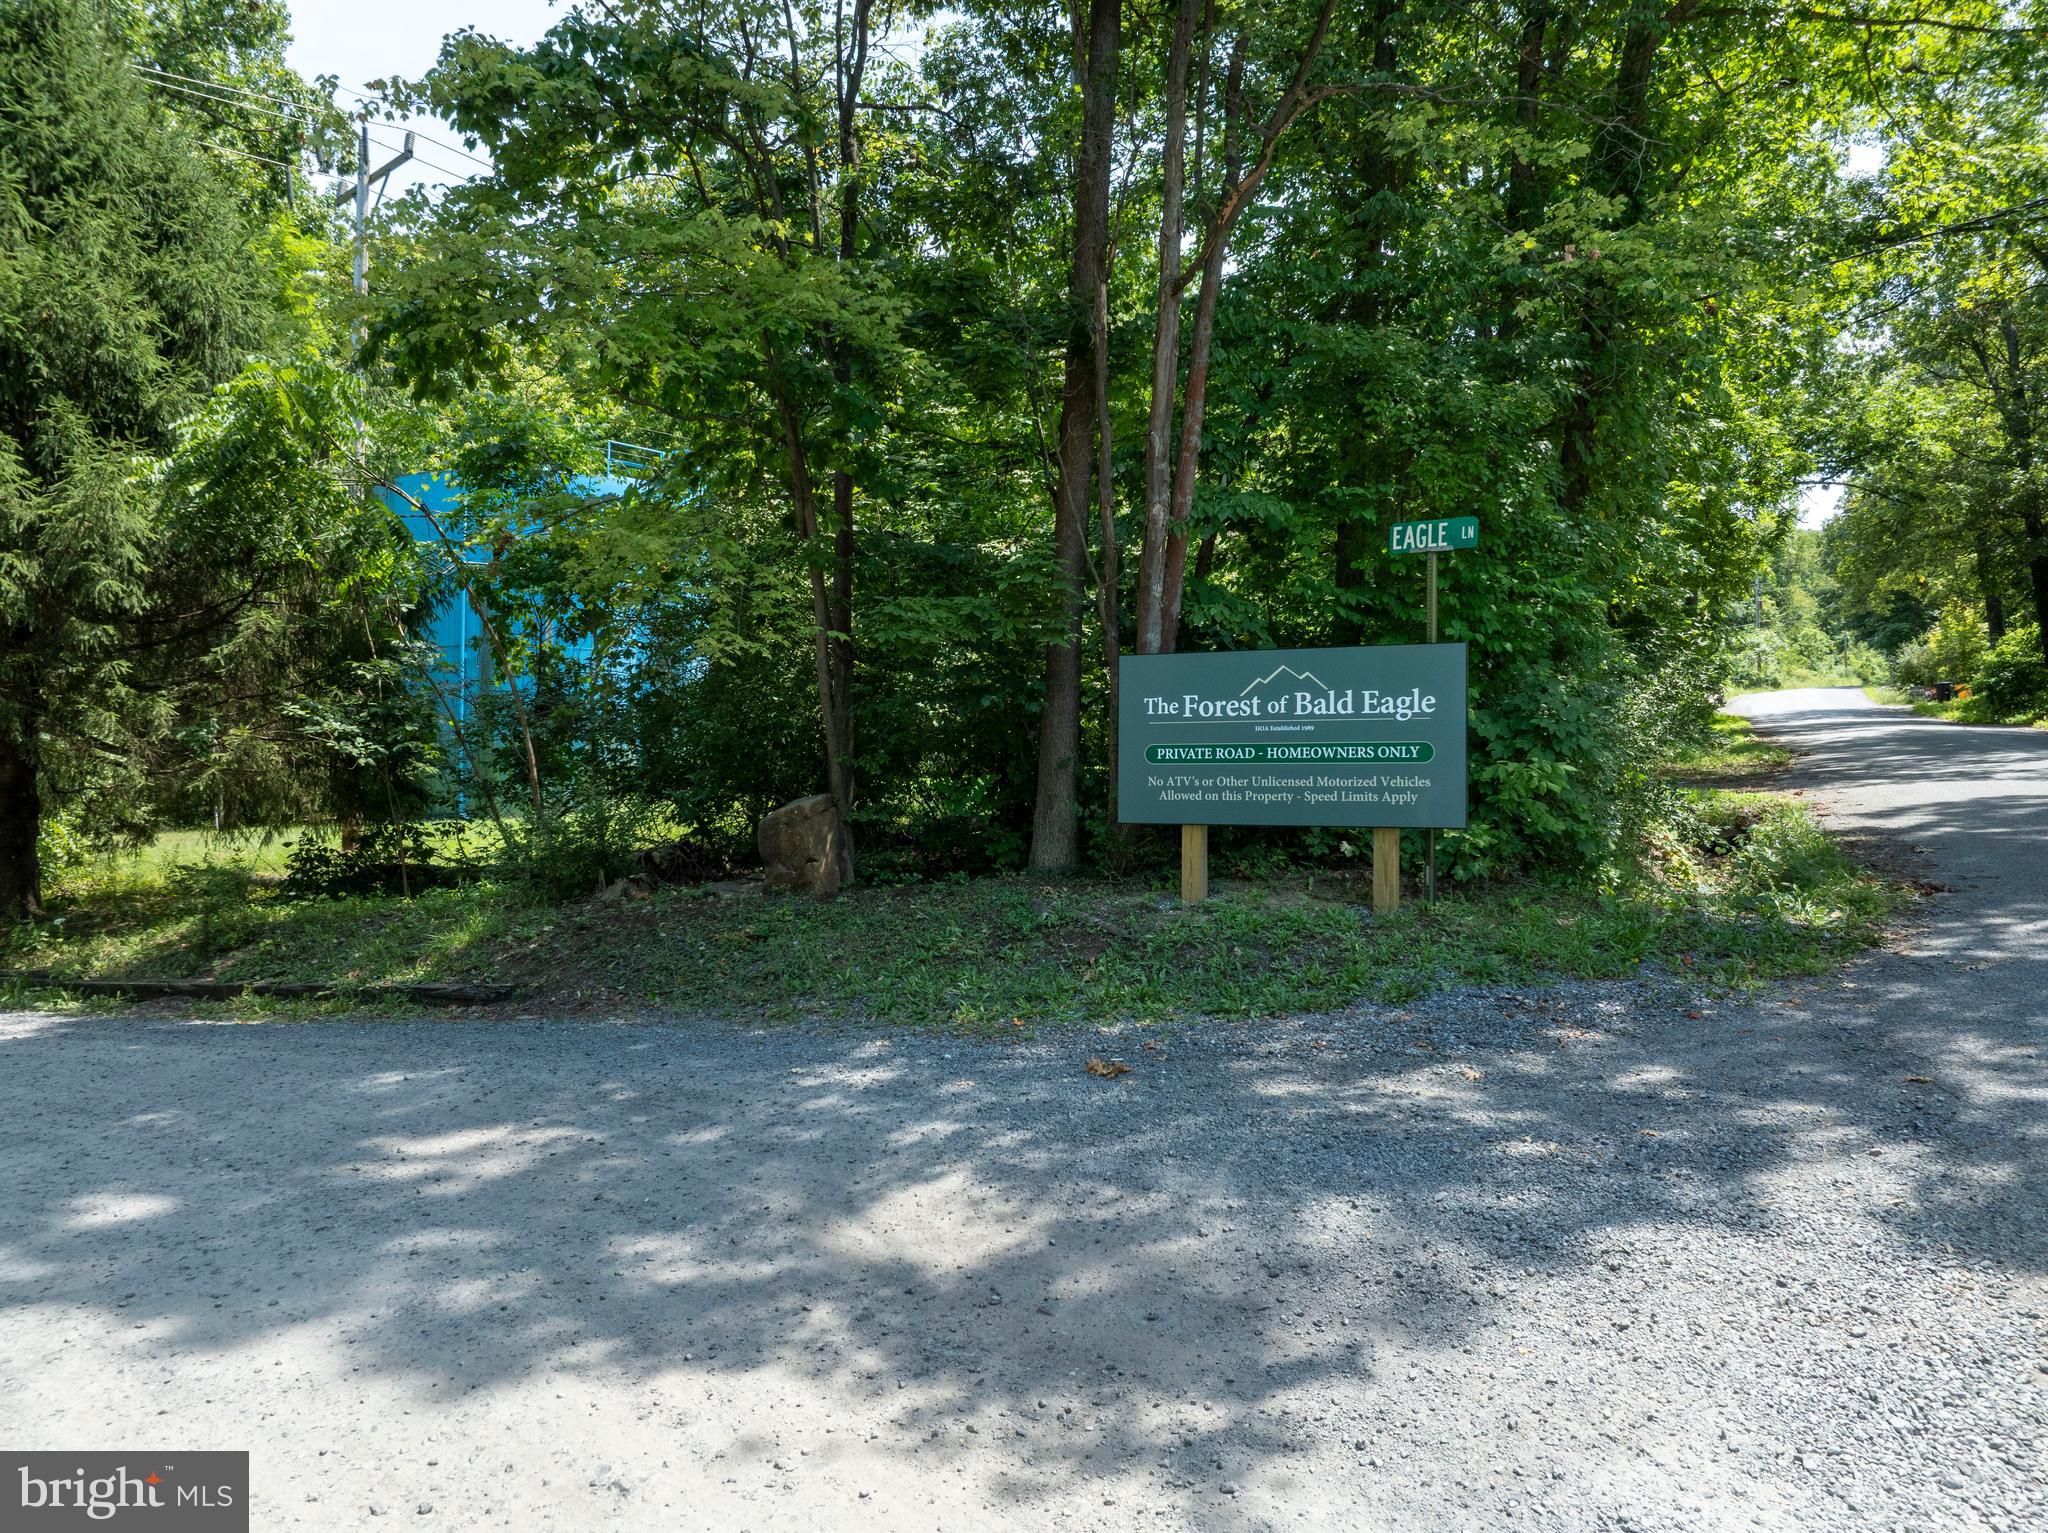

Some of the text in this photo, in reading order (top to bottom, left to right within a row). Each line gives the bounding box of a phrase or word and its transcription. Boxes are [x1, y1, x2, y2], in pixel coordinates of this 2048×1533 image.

[1392, 522, 1474, 550] EAGLE LN
[1144, 688, 1436, 721] The Forest of Bald Eagle
[1157, 748, 1213, 760] PRIVATE
[1215, 747, 1255, 759] ROAD
[1266, 746, 1374, 759] HOMEOWNERS
[1377, 745, 1420, 759] ONLY
[1147, 775, 1432, 788] No ATV's or Other Unlicensed Motorized Vehicles
[1158, 790, 1203, 801] Allowed
[1204, 793, 1219, 801] on
[1221, 790, 1242, 801] this
[1244, 790, 1294, 805] Property
[1303, 790, 1338, 805] Speed
[1340, 790, 1378, 802] Limits
[1381, 790, 1419, 806] Apply
